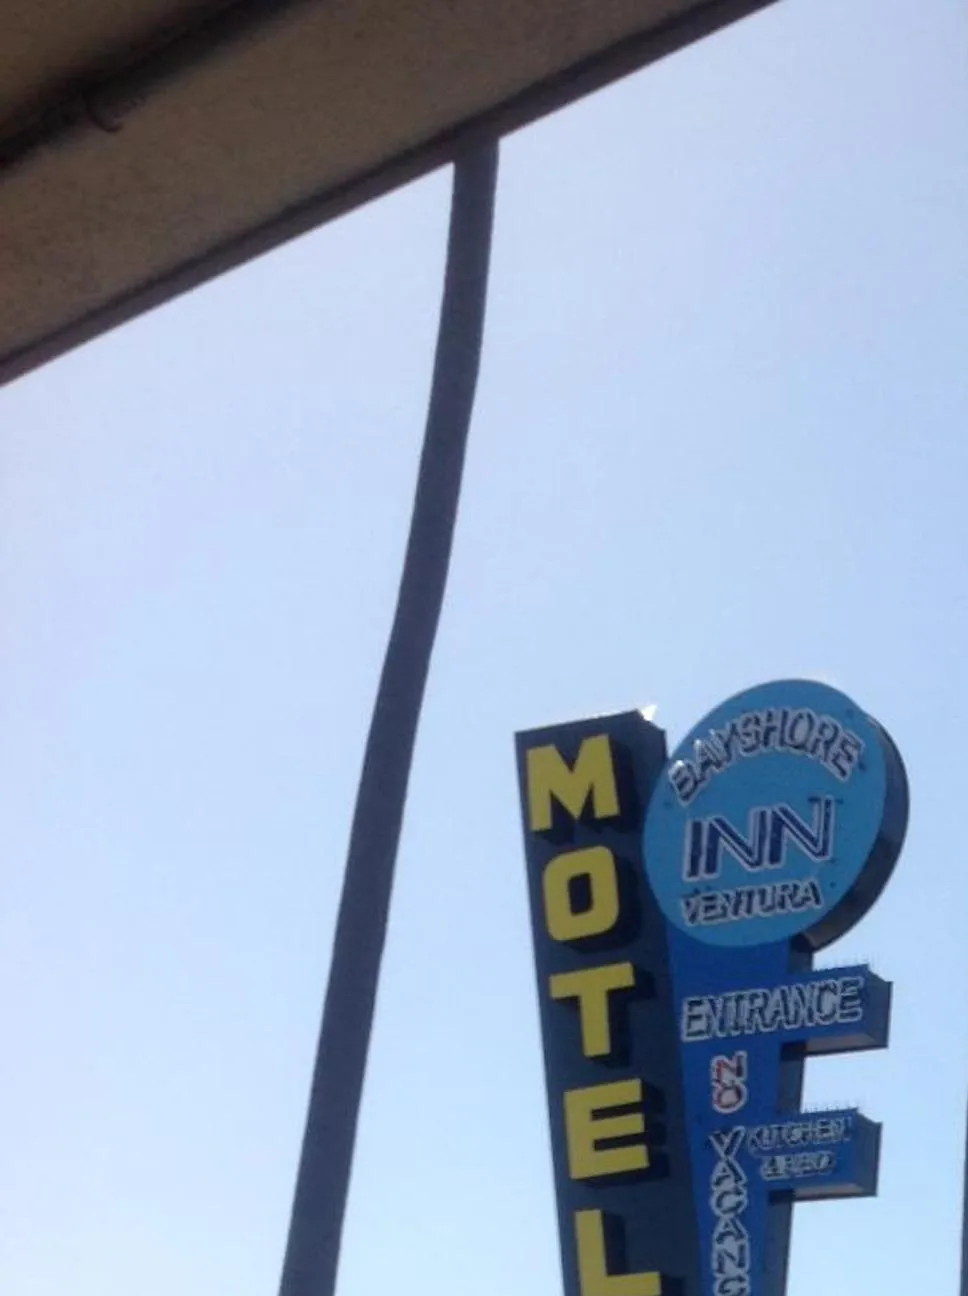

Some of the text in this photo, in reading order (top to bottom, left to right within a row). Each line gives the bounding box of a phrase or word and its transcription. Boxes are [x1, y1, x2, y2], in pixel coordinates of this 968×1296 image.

[669, 708, 865, 805] BAYSHORE
[683, 796, 838, 882] INN
[682, 881, 824, 925] VENTURA
[681, 976, 865, 1043] ENTRANCE
[710, 1050, 748, 1113] NO
